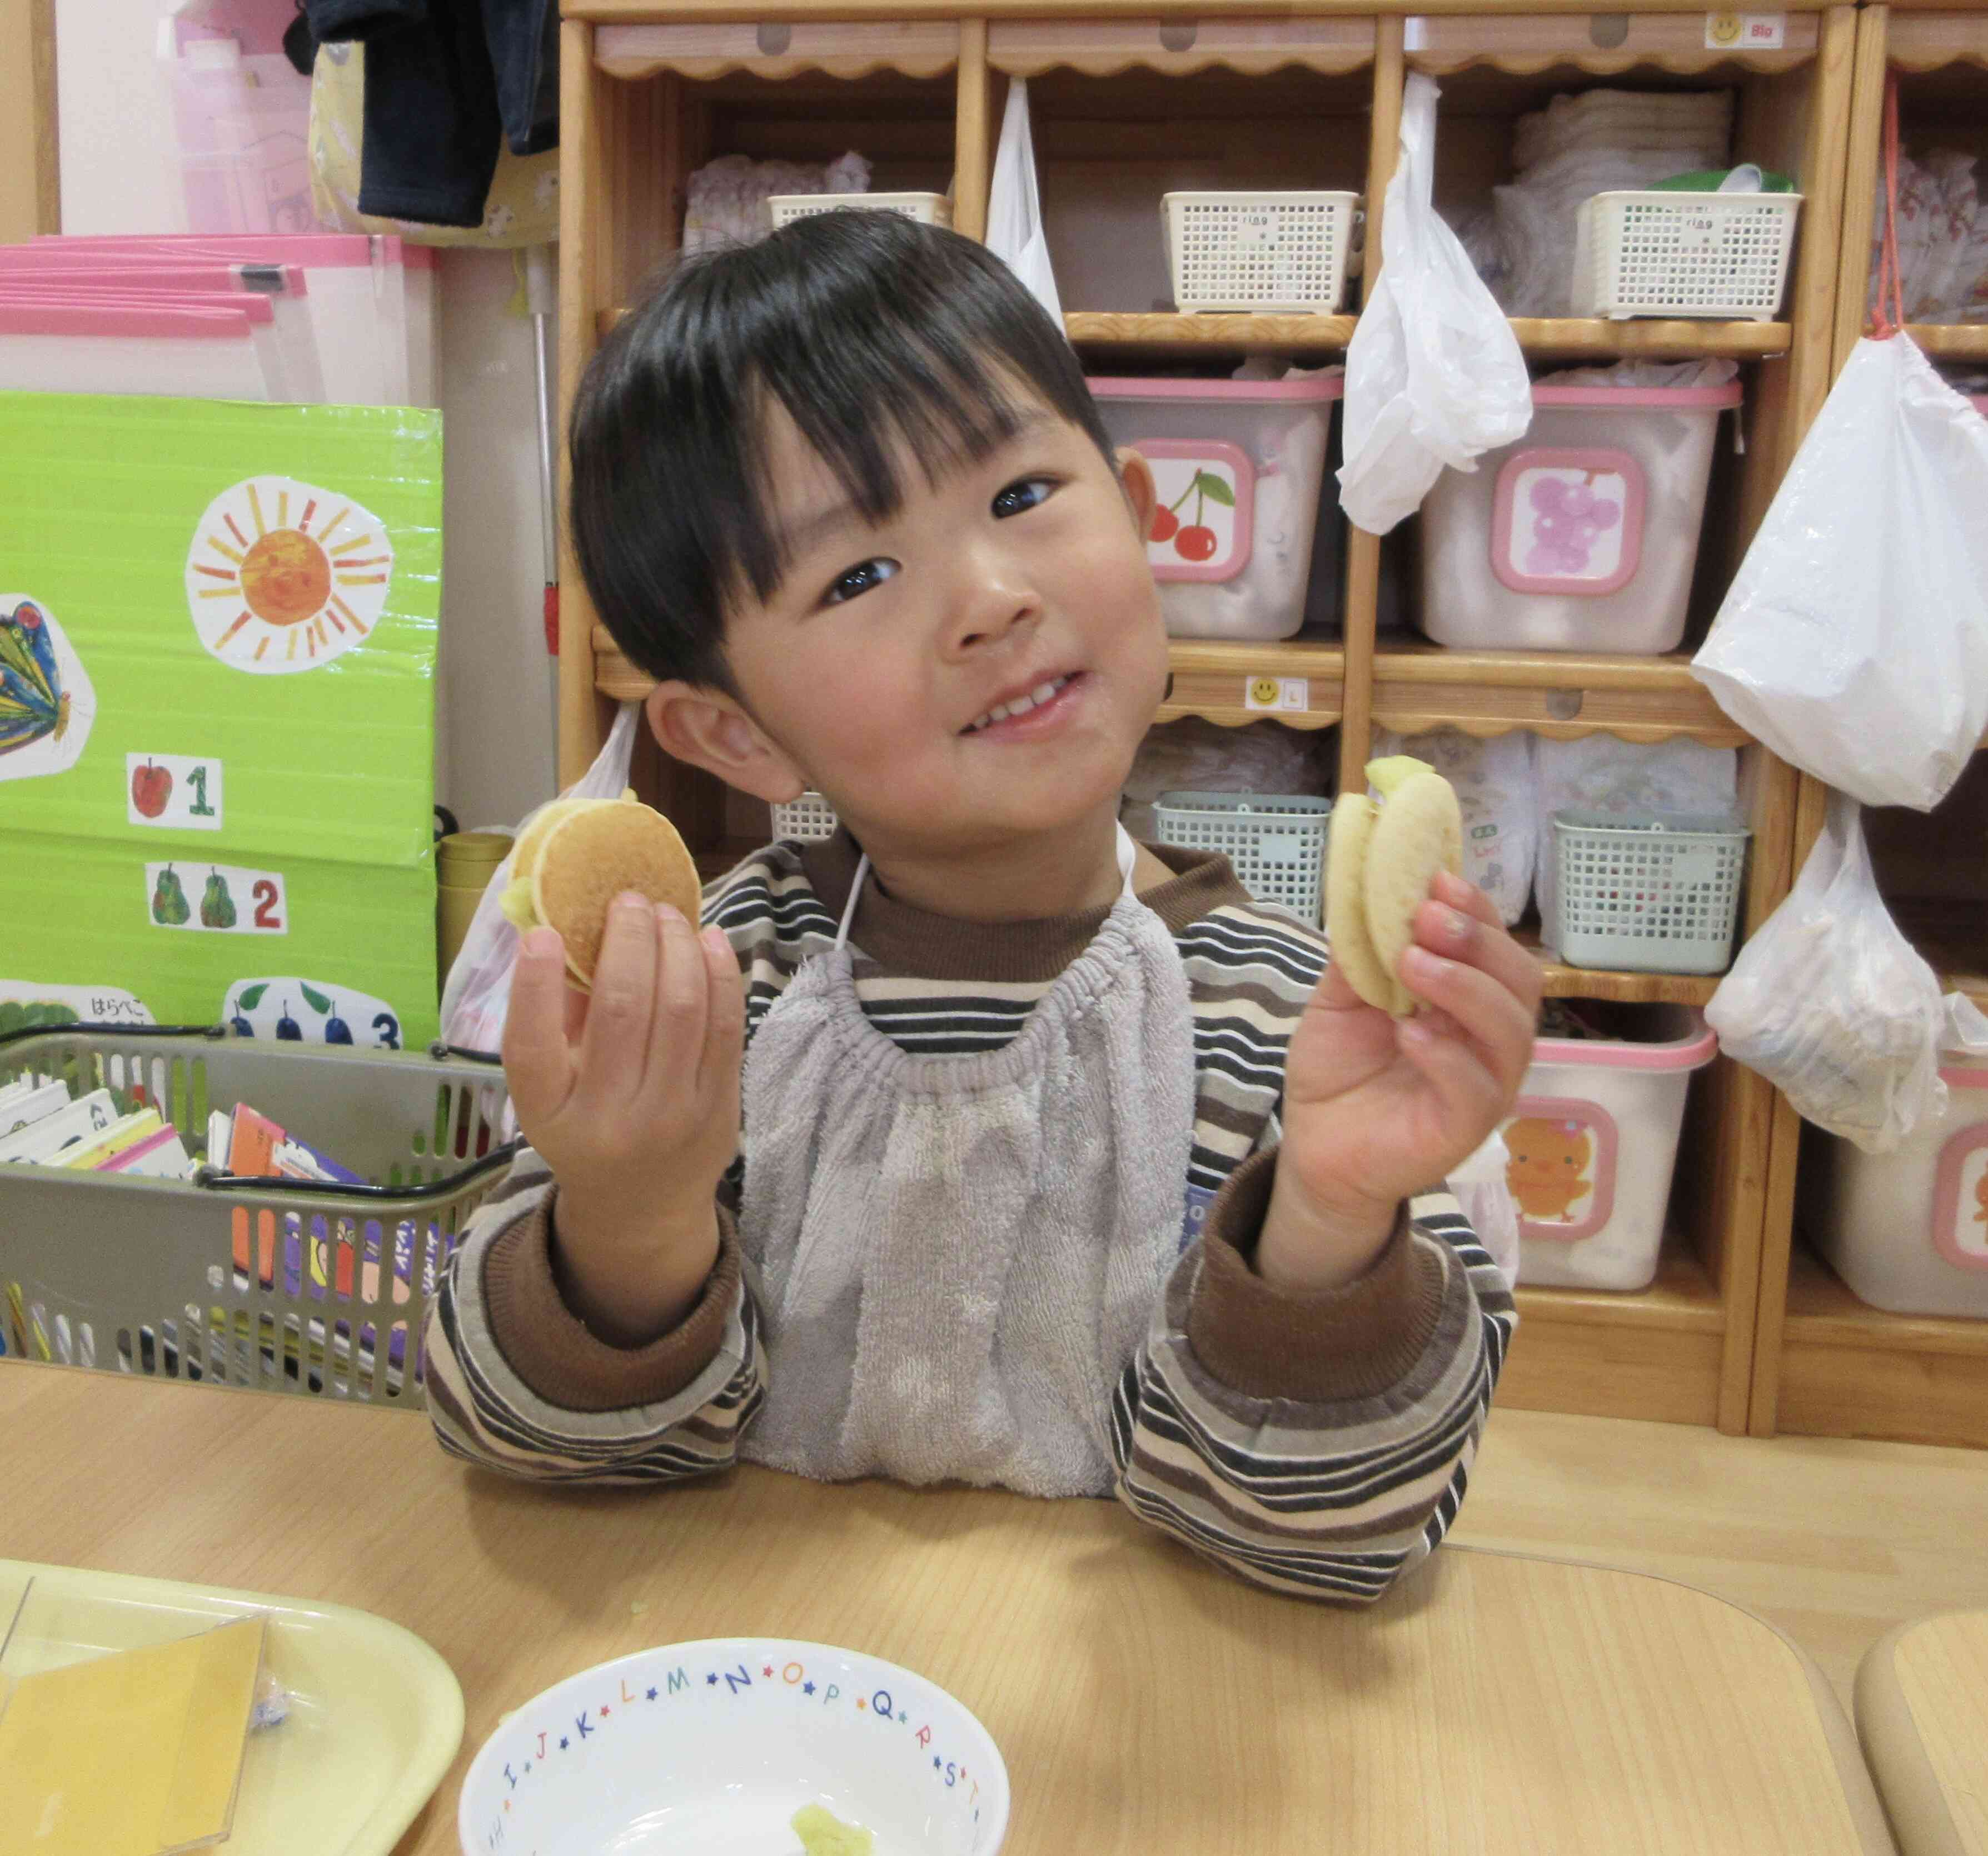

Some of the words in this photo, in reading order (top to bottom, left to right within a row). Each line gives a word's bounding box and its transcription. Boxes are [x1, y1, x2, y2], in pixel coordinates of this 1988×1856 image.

[186, 766, 215, 816] 1
[253, 879, 281, 929] 2
[536, 1732, 547, 1759] J
[575, 1709, 594, 1739] K
[620, 1678, 636, 1703] L
[667, 1666, 690, 1694] M
[725, 1664, 751, 1694] N
[783, 1662, 803, 1684] O
[824, 1683, 839, 1704] P
[873, 1690, 893, 1720] Q
[915, 1725, 931, 1749] R
[945, 1762, 956, 1787] S
